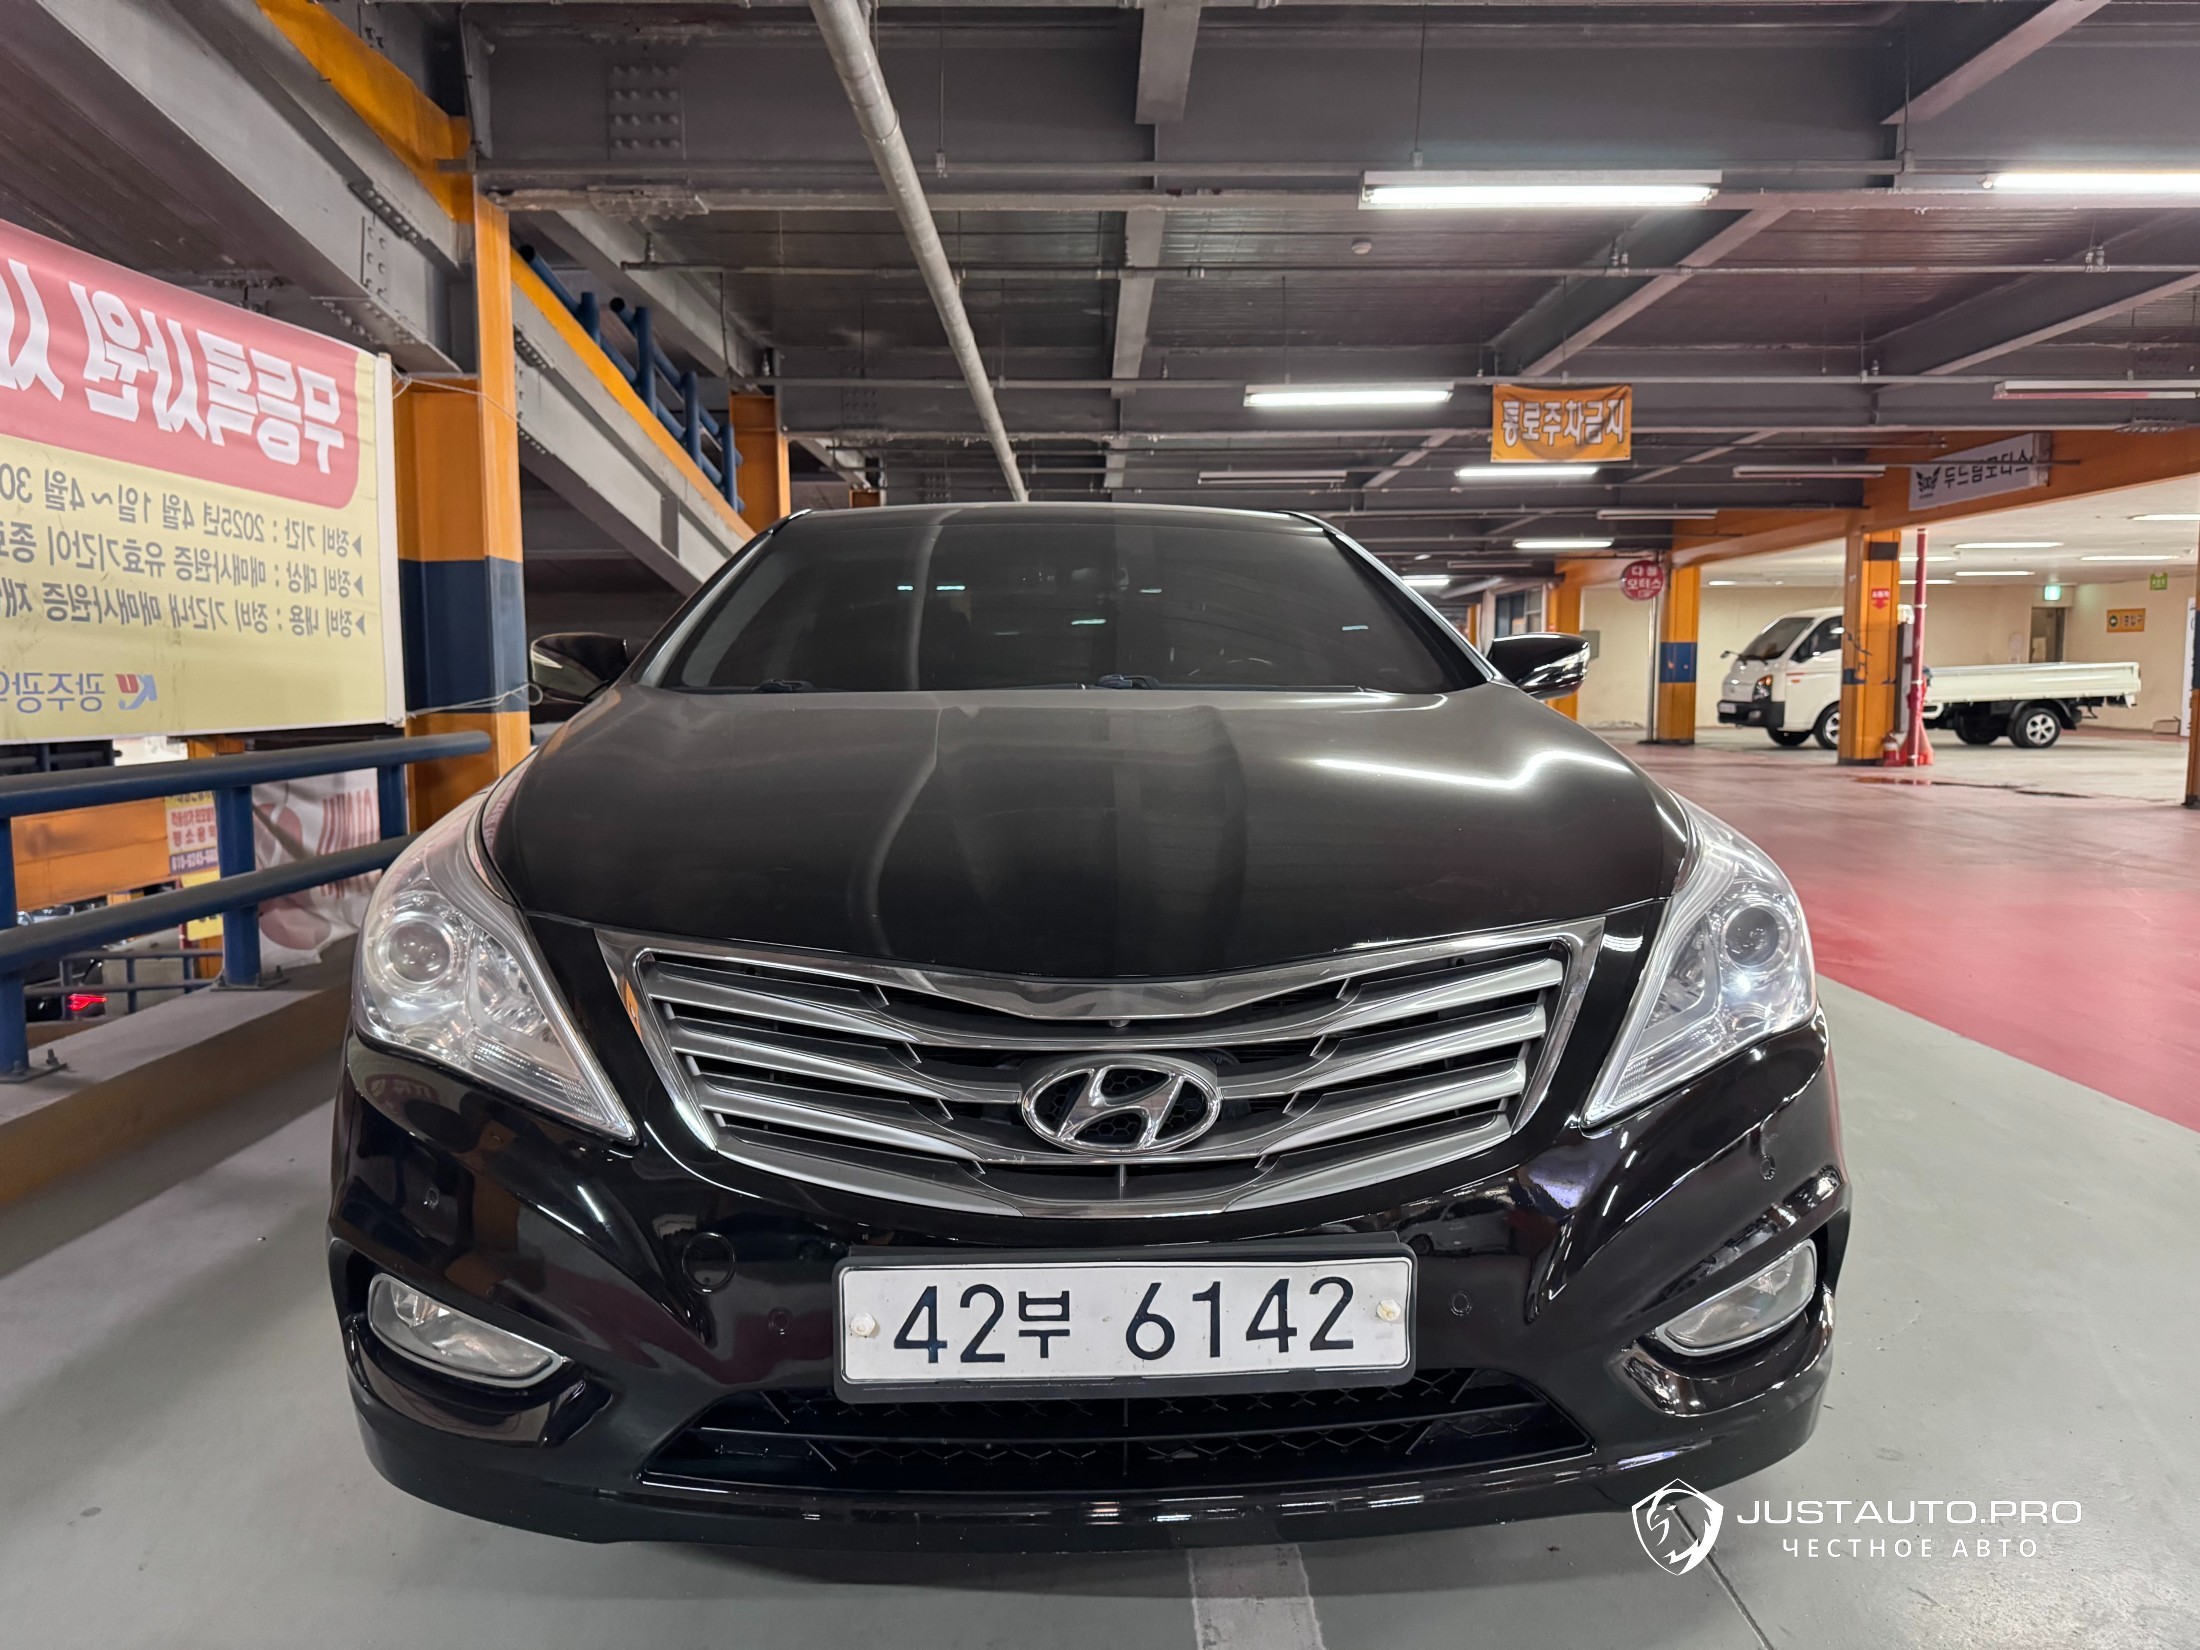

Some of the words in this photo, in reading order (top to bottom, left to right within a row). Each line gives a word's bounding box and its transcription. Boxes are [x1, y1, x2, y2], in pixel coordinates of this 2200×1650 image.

[1502, 399, 1625, 447] 통로주차금지
[893, 1283, 1070, 1364] 42부
[1125, 1275, 1355, 1361] 6142
